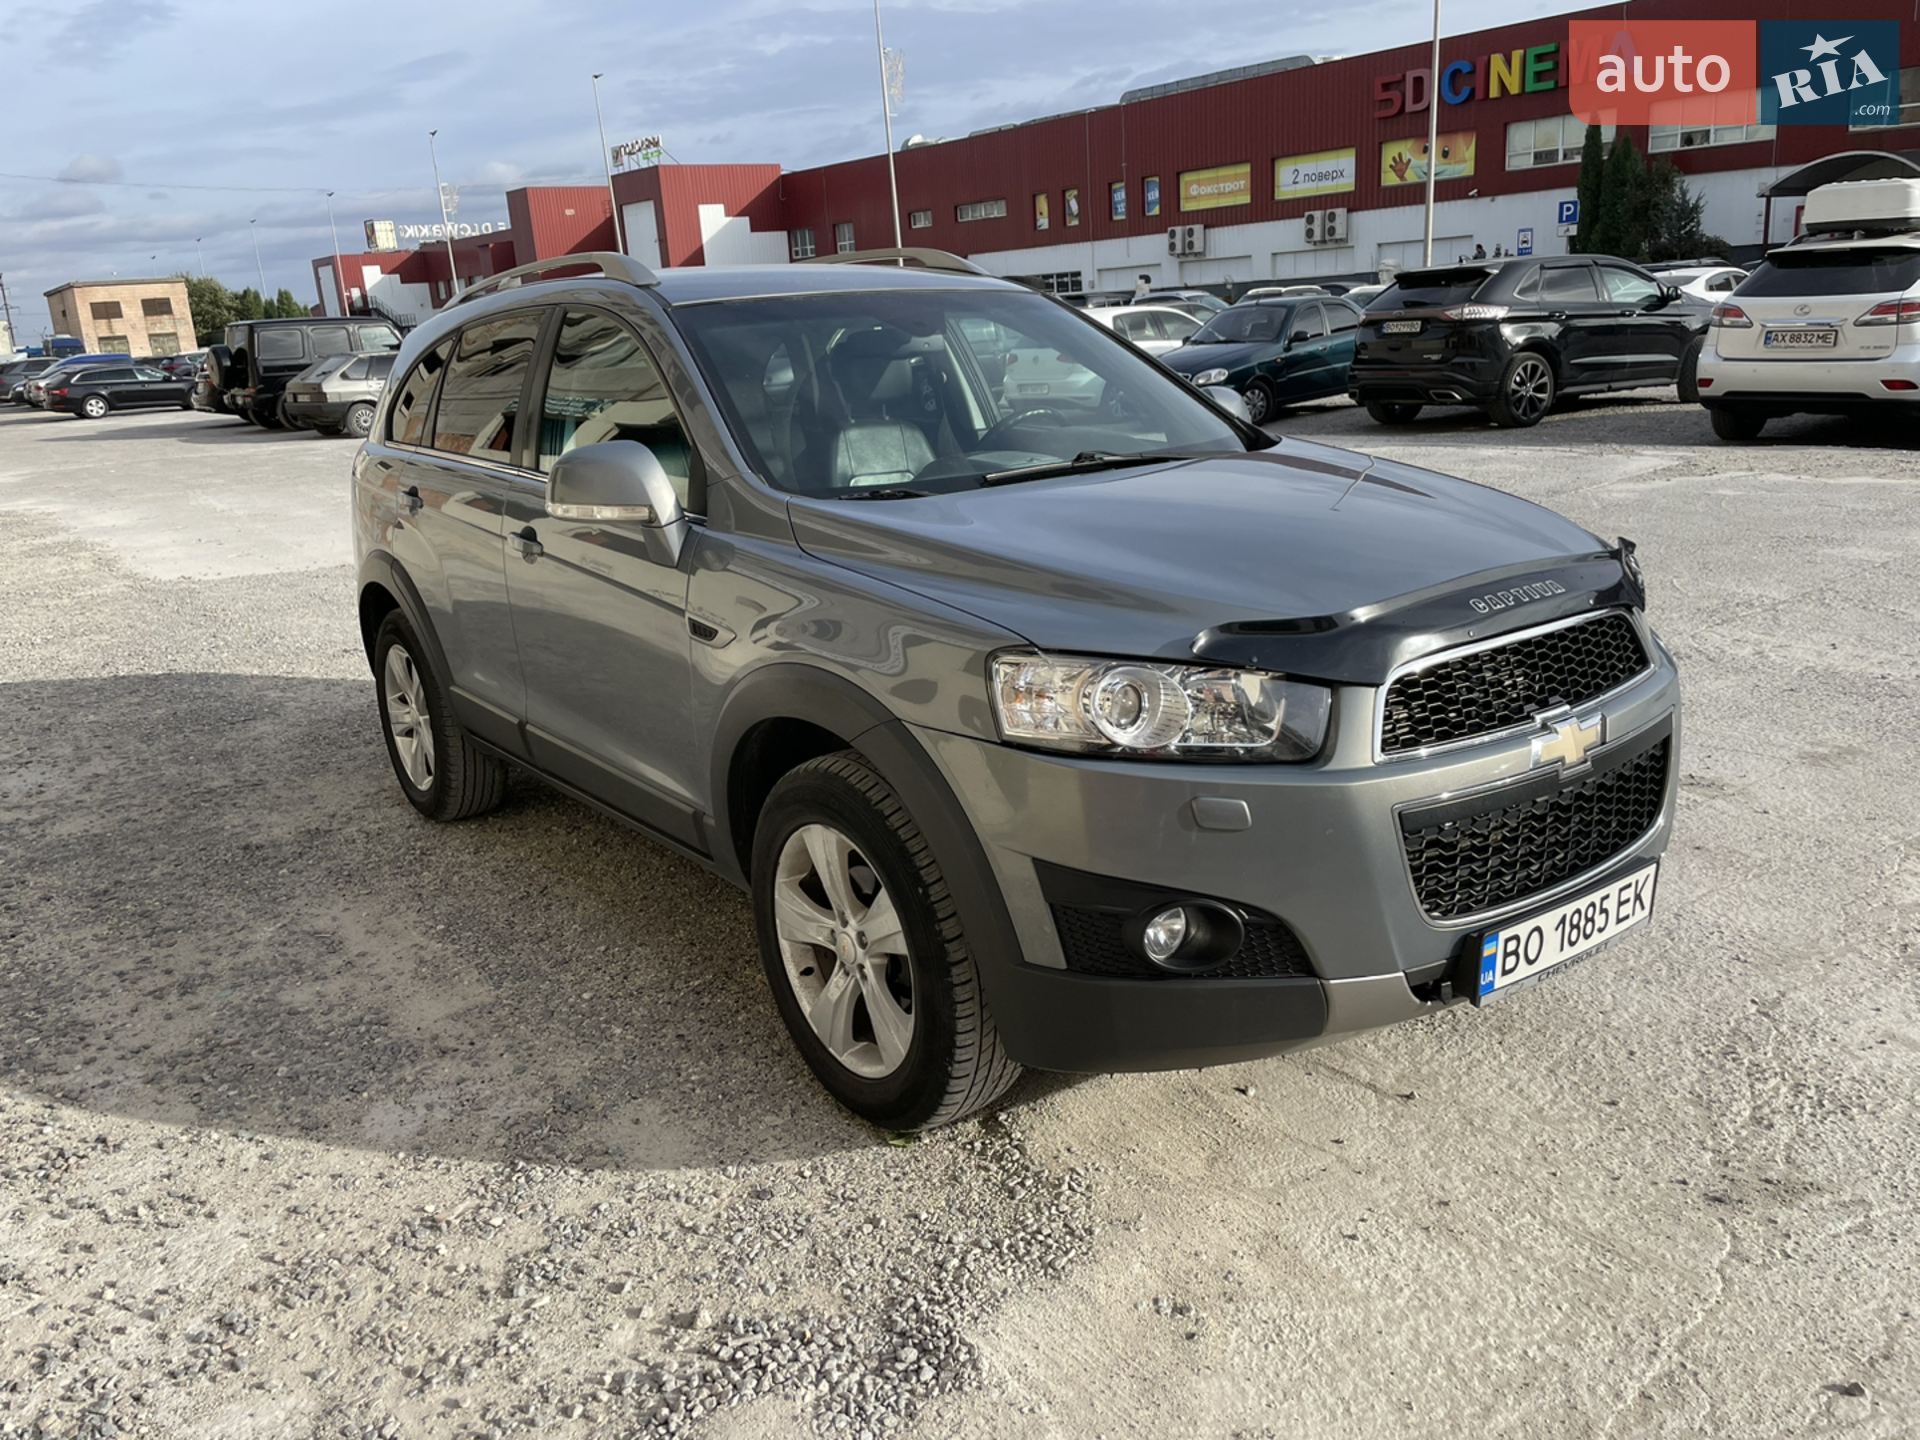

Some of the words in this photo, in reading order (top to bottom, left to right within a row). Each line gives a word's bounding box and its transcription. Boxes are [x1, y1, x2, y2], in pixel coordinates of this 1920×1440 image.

[1292, 168, 1300, 185] 2
[1303, 168, 1345, 184] поверх
[1189, 179, 1246, 197] Фокстрот
[1563, 203, 1575, 222] P
[1469, 580, 1566, 614] CAPTIVA
[1501, 925, 1544, 977] BO
[1555, 893, 1610, 953] 1885
[1615, 874, 1650, 926] EK
[1480, 970, 1494, 985] UA
